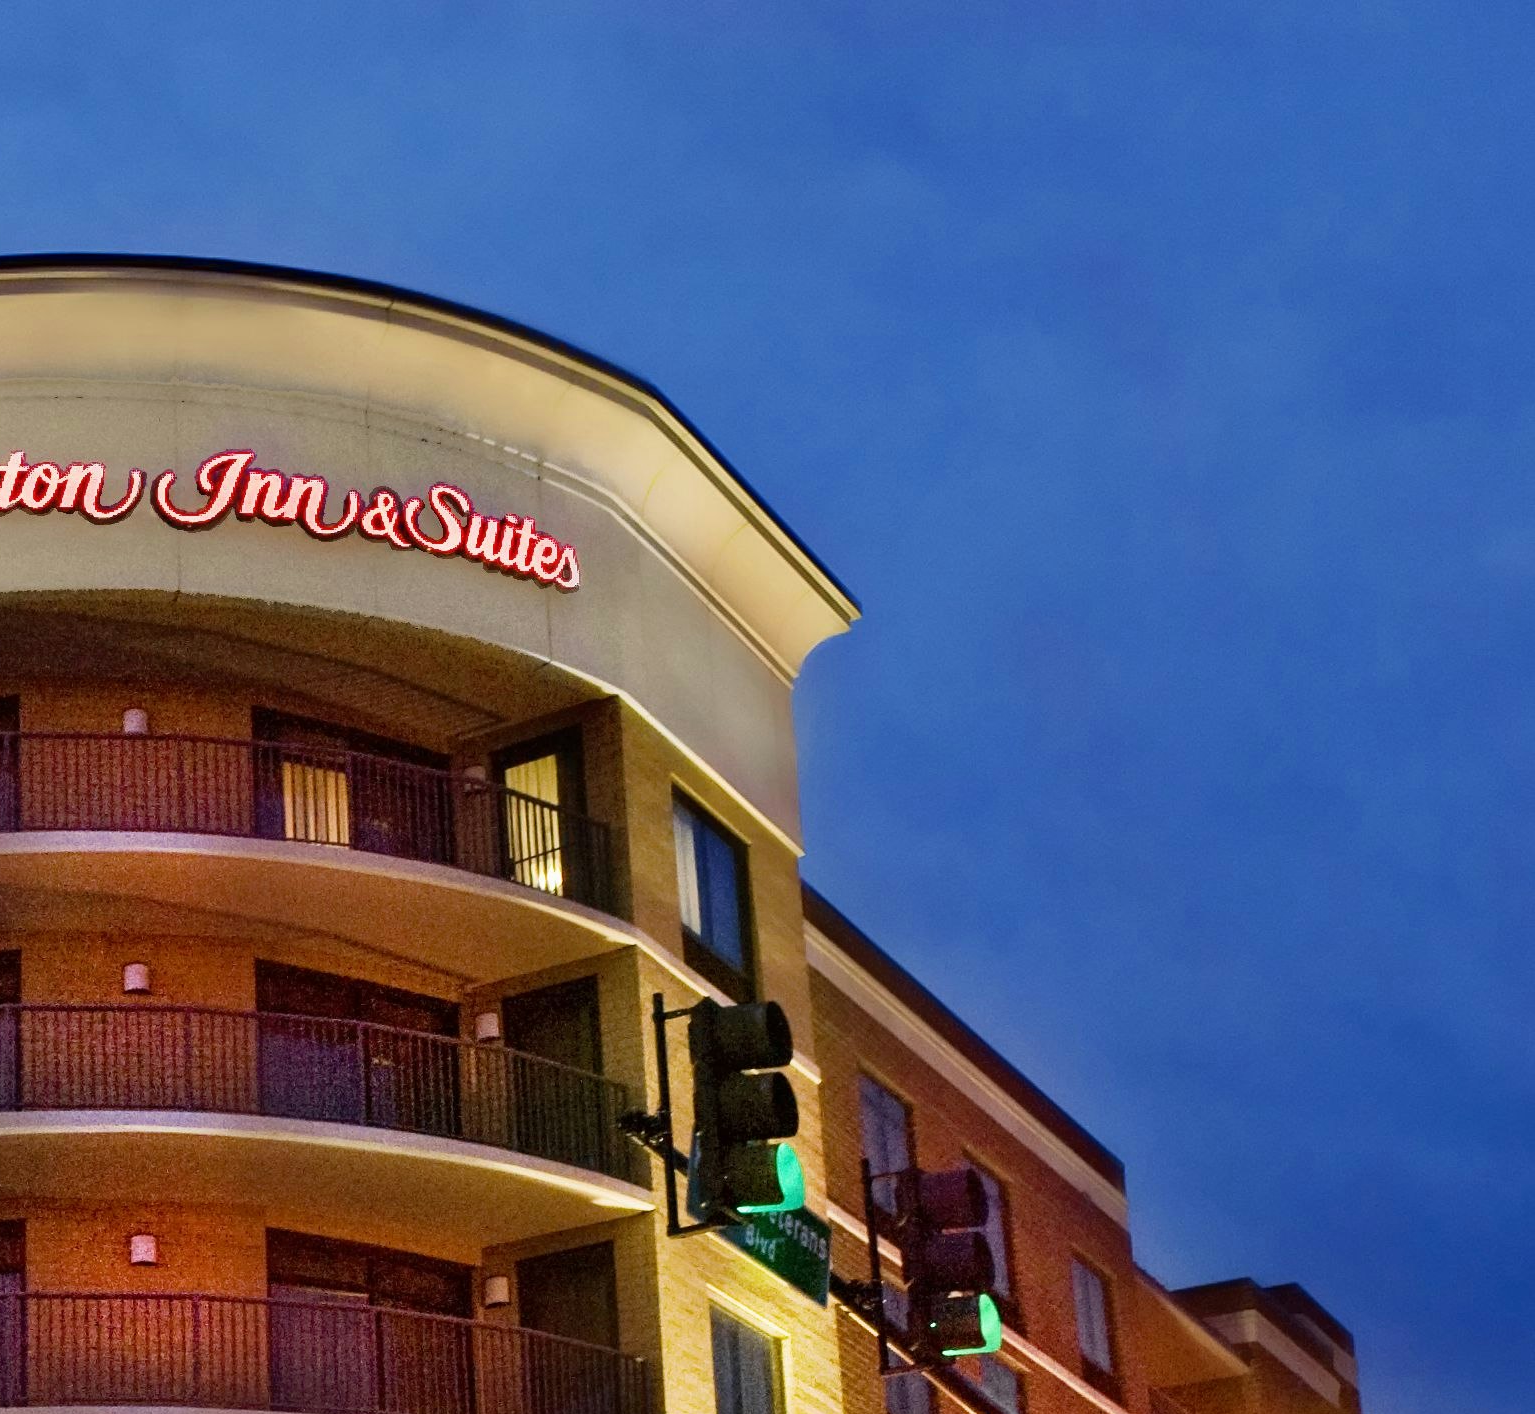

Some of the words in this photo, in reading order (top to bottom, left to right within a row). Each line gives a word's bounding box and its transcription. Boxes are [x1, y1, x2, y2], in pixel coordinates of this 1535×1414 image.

[152, 447, 359, 538] Inn
[358, 487, 413, 549] &
[404, 482, 581, 592] Suites
[745, 1223, 776, 1263] Blvd
[761, 1211, 828, 1261] eterans
